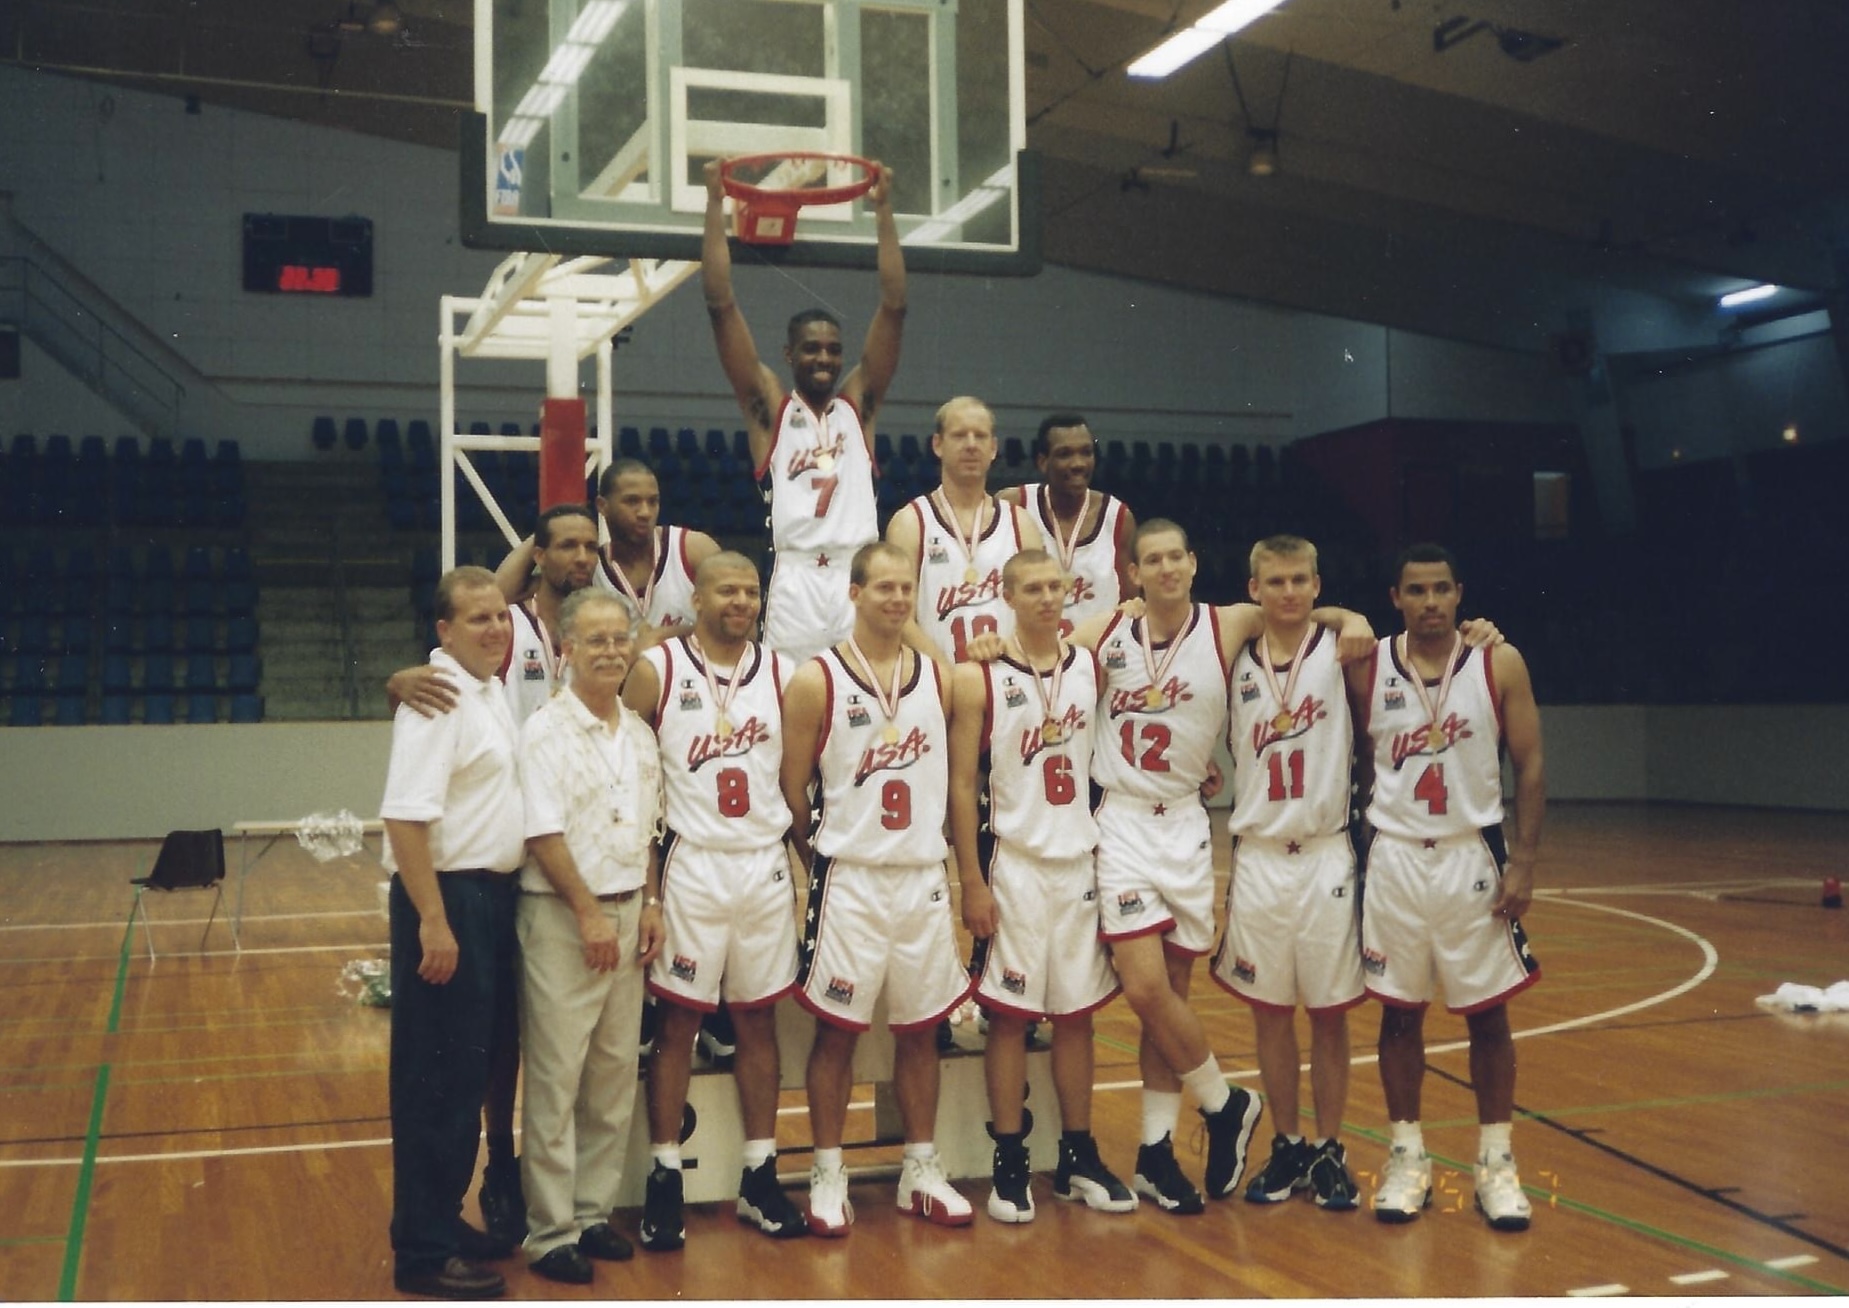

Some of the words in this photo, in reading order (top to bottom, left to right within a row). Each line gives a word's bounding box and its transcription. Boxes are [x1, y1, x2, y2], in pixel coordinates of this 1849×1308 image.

[811, 474, 838, 518] 7
[1120, 720, 1171, 772] 12
[716, 767, 750, 818] 8
[1043, 754, 1076, 806] 6
[1267, 750, 1304, 802] 11
[1414, 763, 1448, 815] 4
[881, 779, 911, 830] 9
